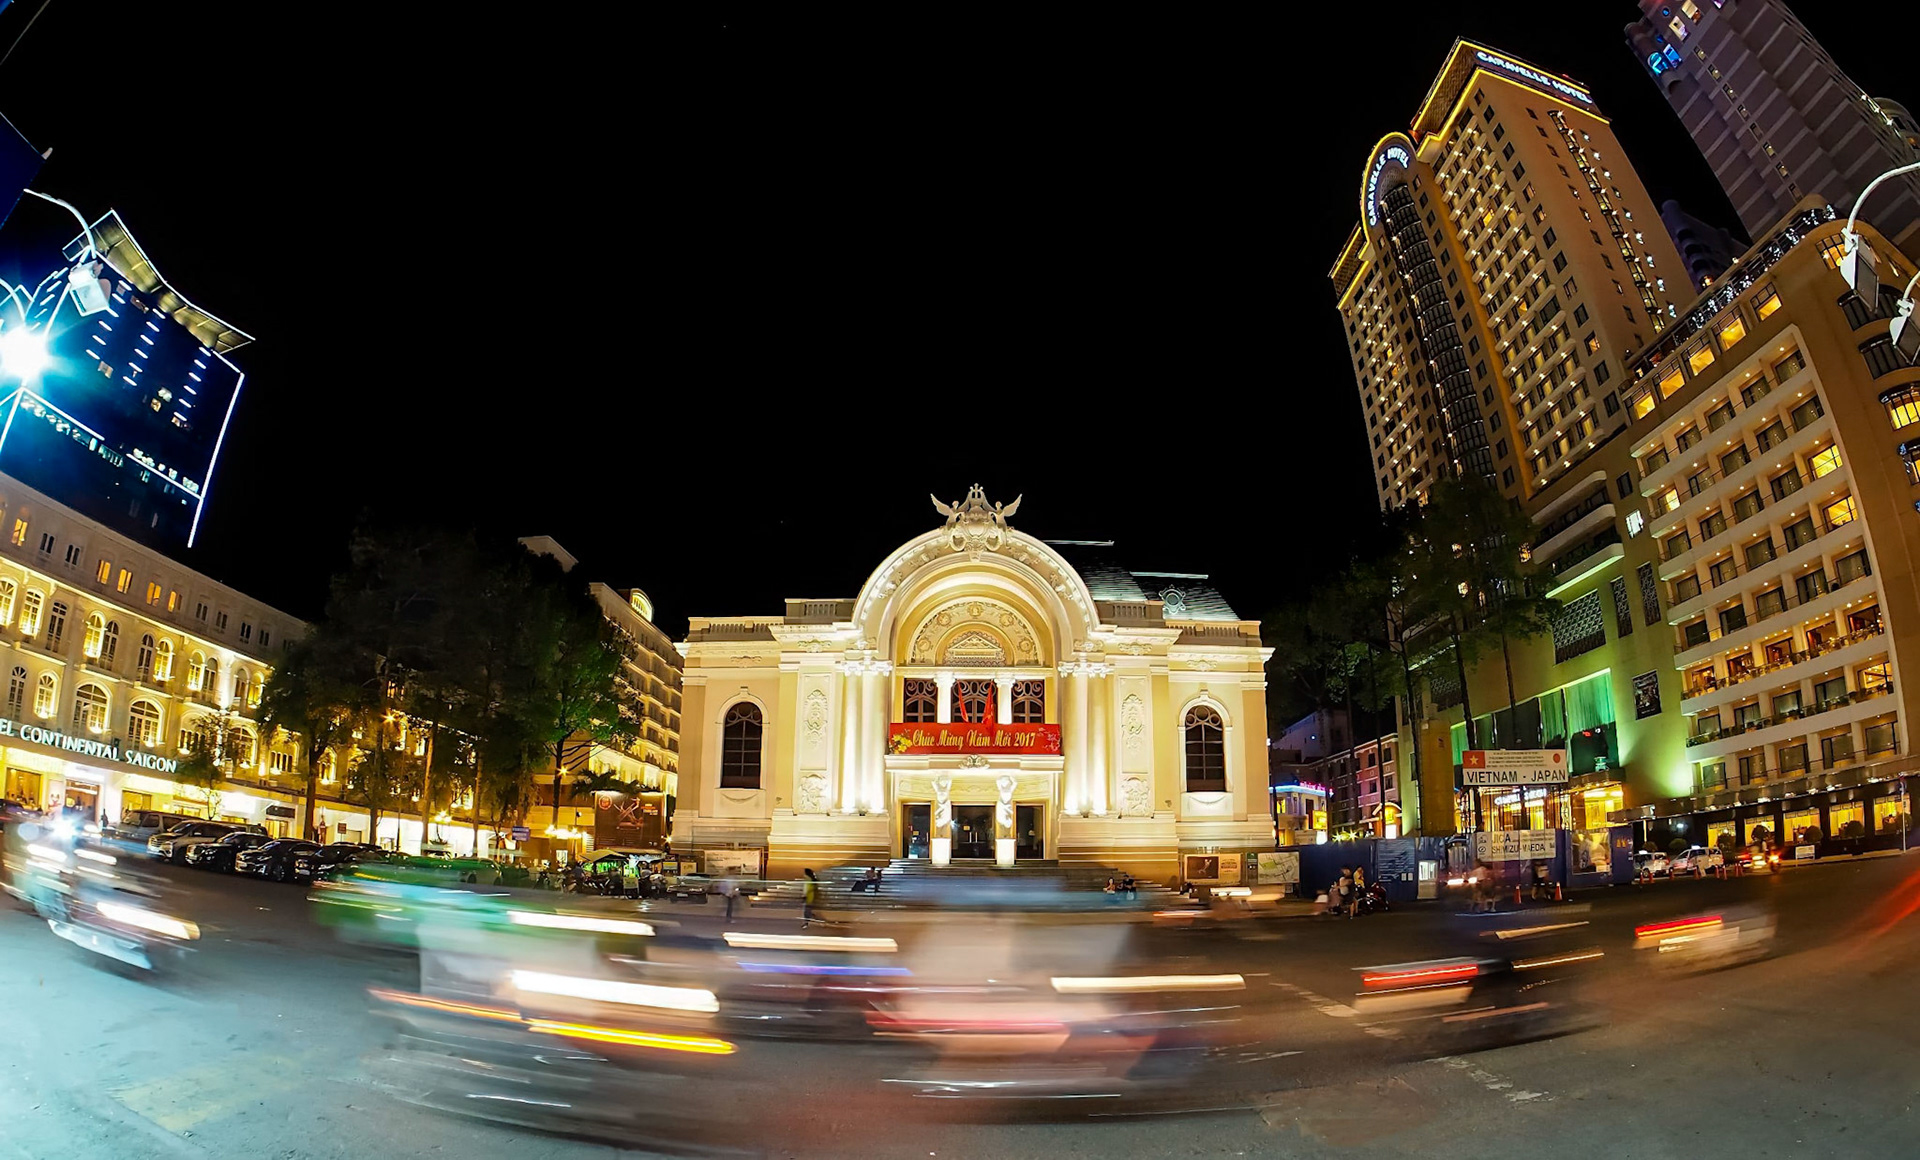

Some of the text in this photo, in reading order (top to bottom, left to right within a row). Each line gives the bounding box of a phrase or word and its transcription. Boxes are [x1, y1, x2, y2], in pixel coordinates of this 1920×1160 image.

[1476, 51, 1593, 104] CARAVELLE HOTEL
[1367, 147, 1409, 226] CARAVELLE HOTEL
[20, 724, 120, 762] CONTINENTAL
[125, 750, 177, 773] SAIGON
[1014, 732, 1036, 747] 2017
[1466, 771, 1518, 783] VIETNAM
[1531, 769, 1566, 782] JAPAN
